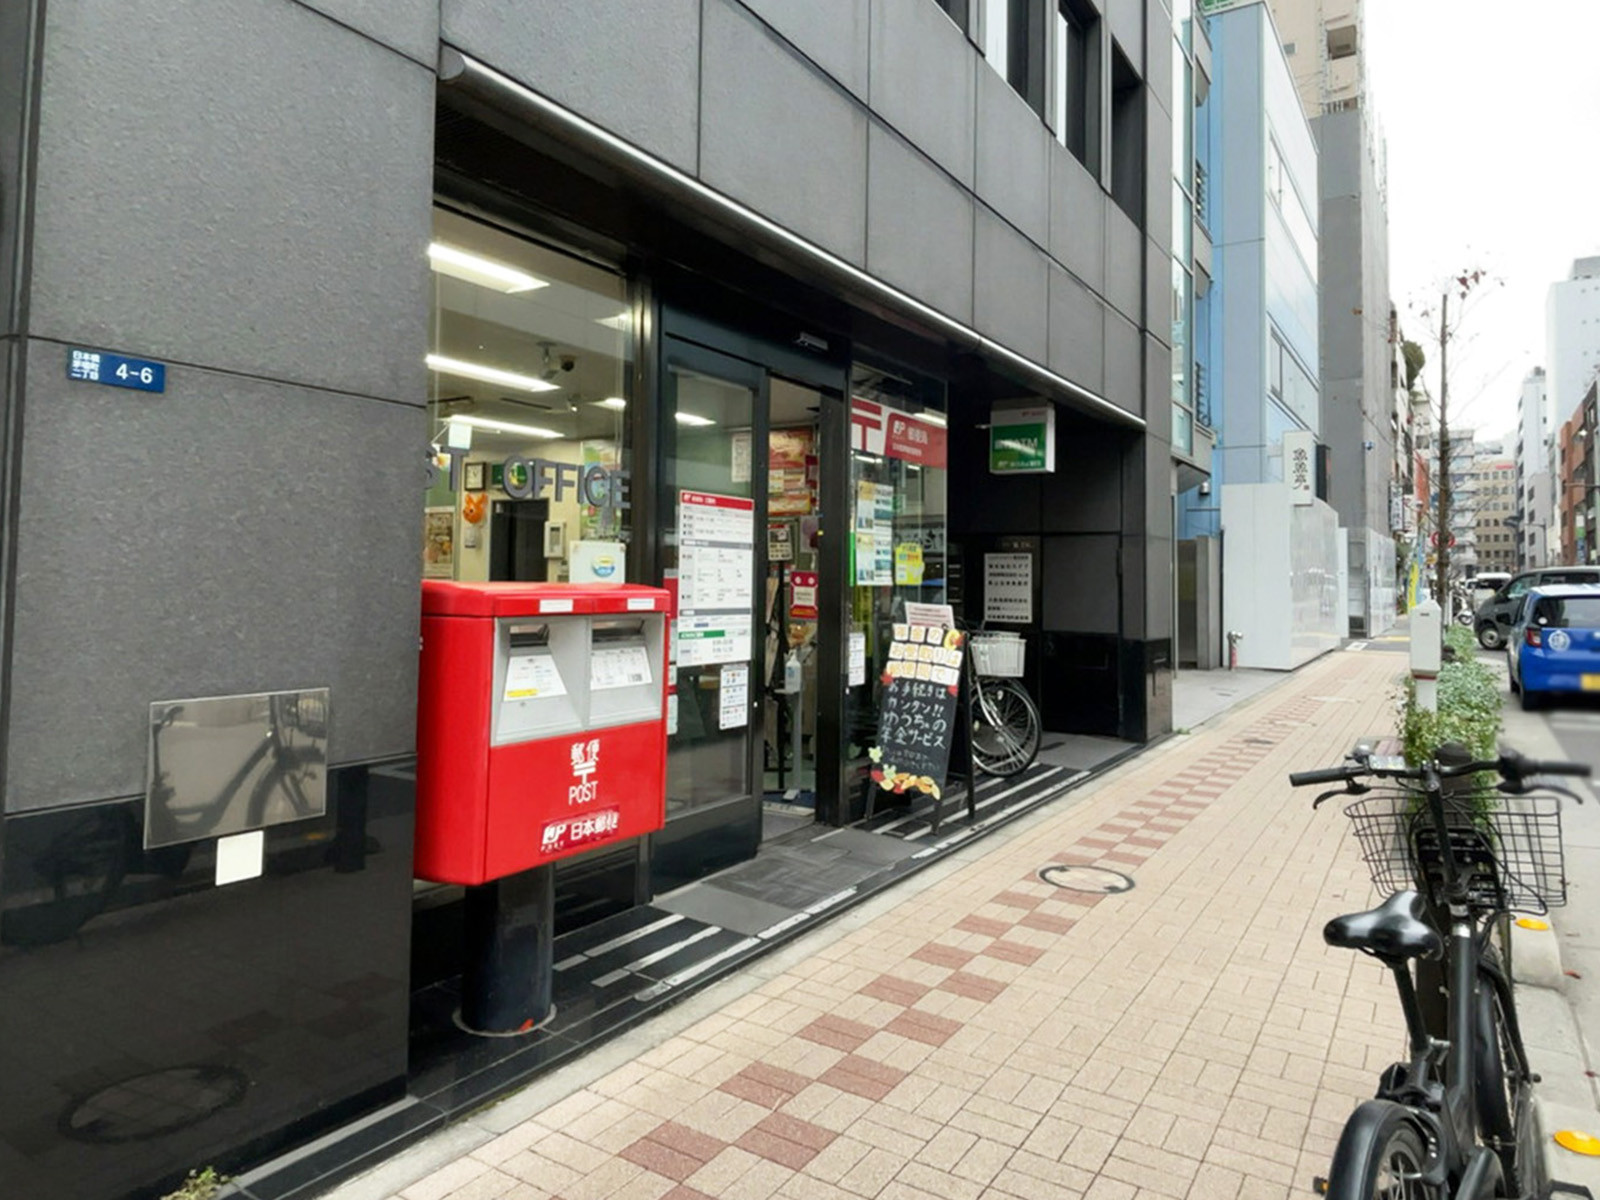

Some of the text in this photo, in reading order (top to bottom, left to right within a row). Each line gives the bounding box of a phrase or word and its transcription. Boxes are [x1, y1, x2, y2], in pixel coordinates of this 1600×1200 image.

[115, 363, 153, 384] 4-6
[503, 453, 631, 509] OFFICE
[888, 680, 946, 699] お手続きは
[881, 726, 946, 749] 年金サービス
[571, 739, 600, 766] 郵便
[568, 781, 598, 806] POST
[570, 812, 619, 841] 日本郵便
